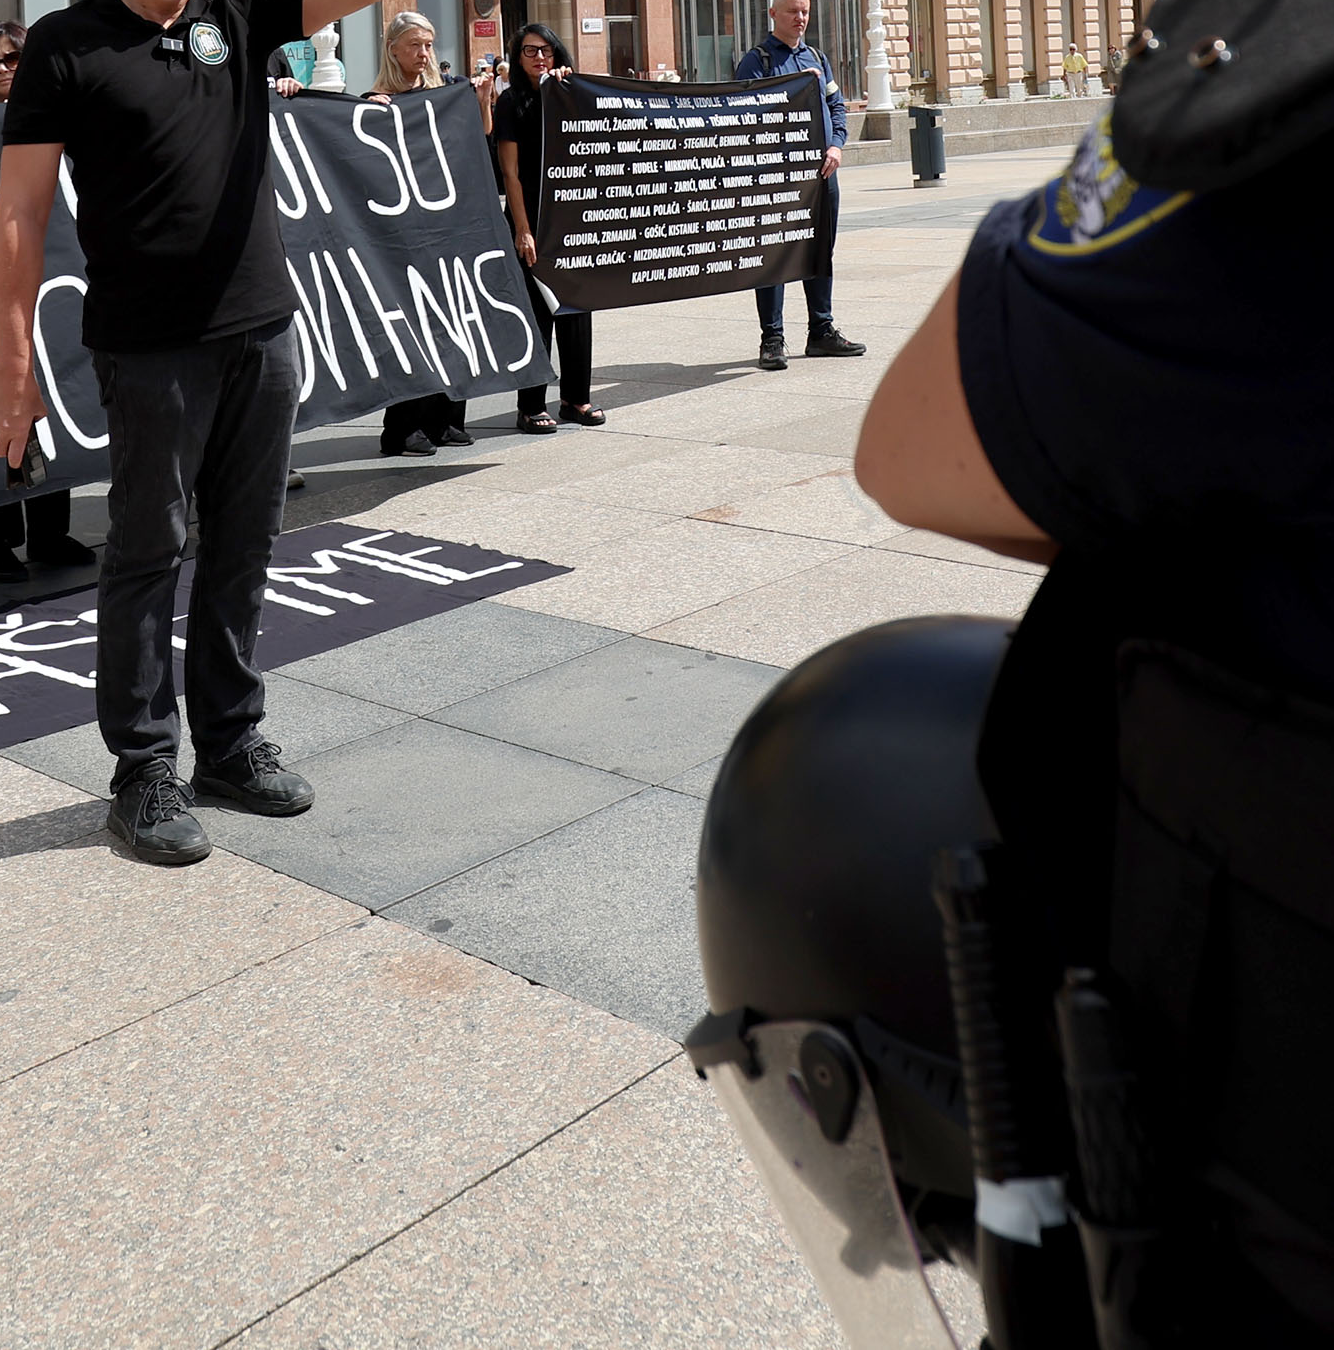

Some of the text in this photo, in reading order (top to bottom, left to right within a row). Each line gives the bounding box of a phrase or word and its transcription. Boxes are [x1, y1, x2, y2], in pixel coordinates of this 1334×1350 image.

[287, 46, 312, 61] ALE
[561, 118, 611, 133] DMITROVIĆI,
[613, 116, 649, 130] ŽAGROVIĆ
[643, 138, 677, 152] KORENICA
[719, 134, 751, 148] BENKOVAC
[353, 100, 458, 217] SU
[547, 163, 587, 178] GOLUBIĆ
[595, 164, 625, 177] VRBNIK
[632, 161, 659, 174] RUDELE
[701, 154, 726, 170] POLAČA
[554, 188, 597, 202] PROKLJAN
[605, 185, 635, 198] CETINA,
[635, 182, 667, 196] CIVLJANI
[698, 176, 717, 190] ORLIĆ
[722, 175, 753, 189] VARIVODE
[759, 172, 785, 185] GRUBORI
[583, 208, 629, 223] CRNOGORCI,
[629, 206, 651, 218] MALA
[653, 201, 681, 216] POLAČA
[563, 232, 601, 247] GUDURA,
[601, 229, 637, 244] ZRMANJA
[644, 224, 667, 239] GOŠIĆ,
[668, 222, 699, 236] KISTANJE
[727, 216, 755, 230] KISTANJE
[555, 255, 595, 270] PALANKA,
[595, 250, 627, 266] GRAČAC
[633, 244, 687, 262] MIZDRAKOVAC,
[687, 241, 716, 256] STRMICA
[722, 236, 756, 252] ZALUŽNICA
[631, 255, 764, 284] KAPLJUH, BRAVSKO SVODNA ŽIROVAC
[406, 249, 534, 386] NAS
